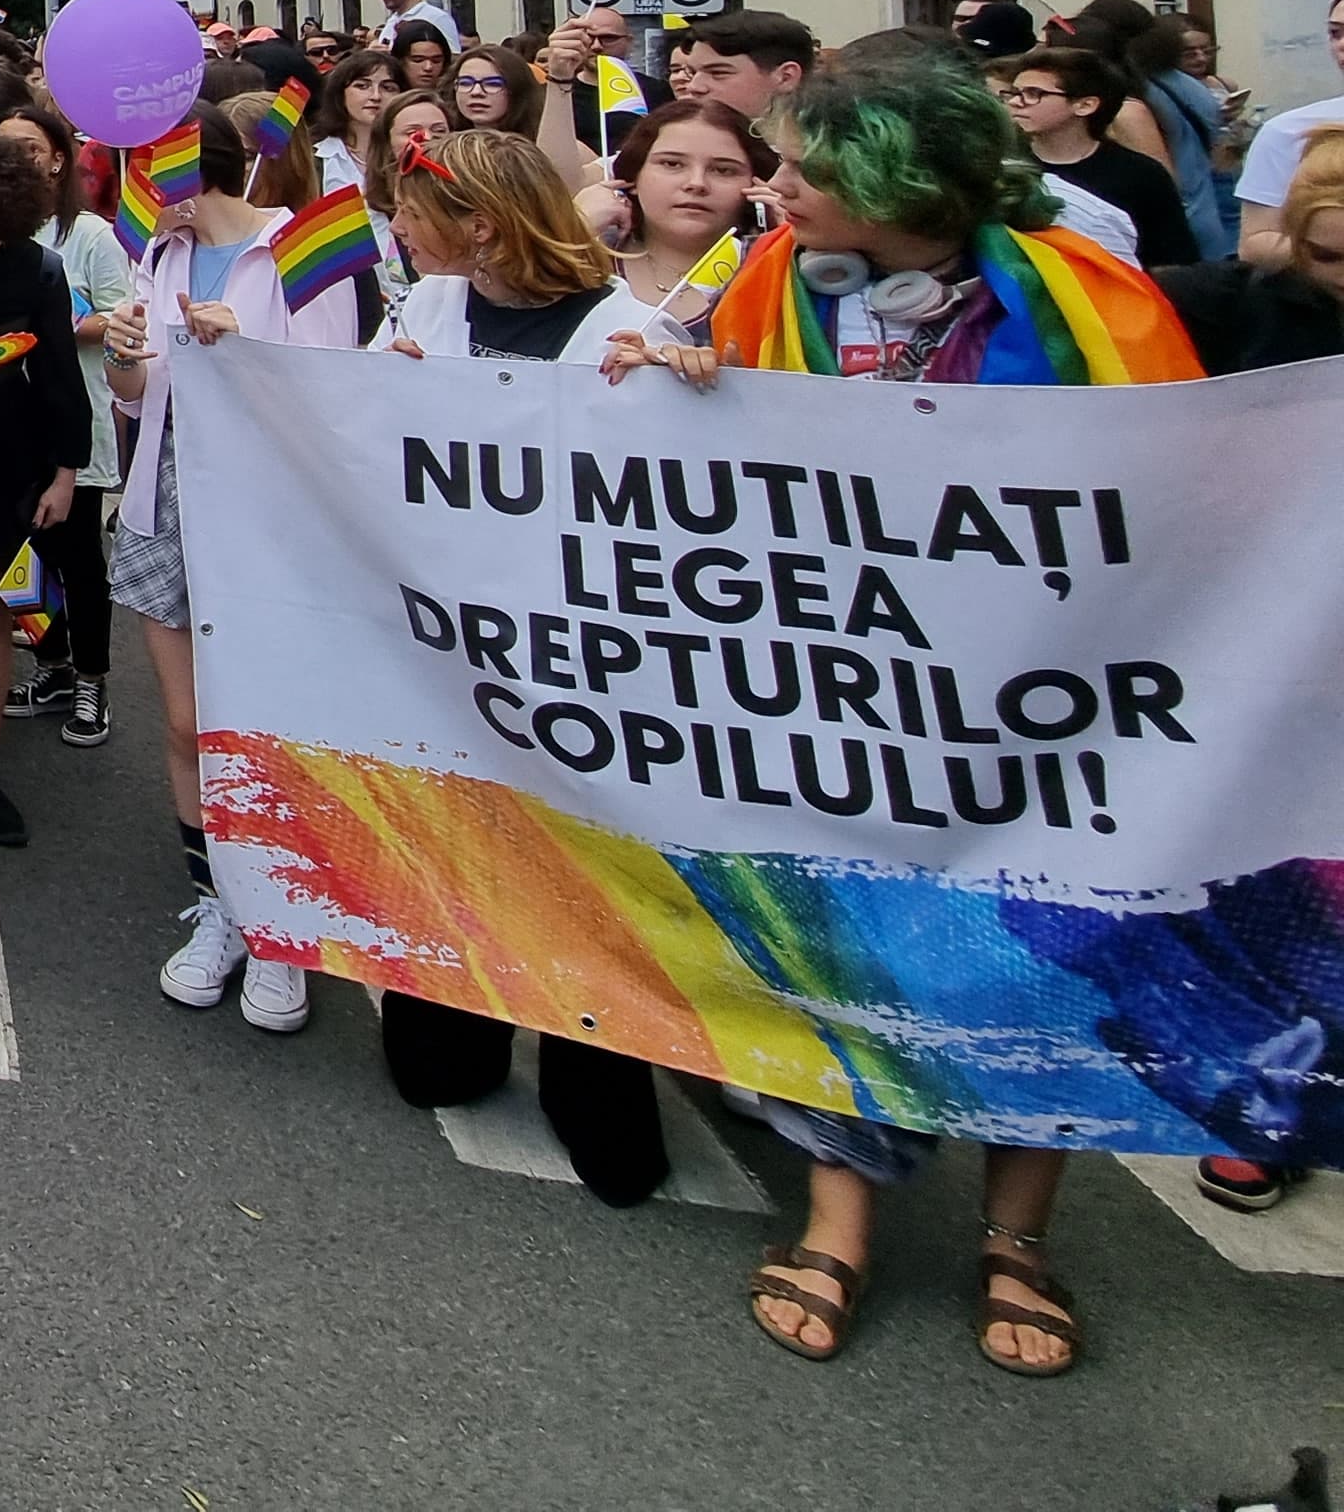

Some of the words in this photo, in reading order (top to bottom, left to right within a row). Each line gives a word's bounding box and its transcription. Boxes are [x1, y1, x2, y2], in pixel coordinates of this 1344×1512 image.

[402, 435, 544, 517] NU
[569, 450, 1132, 603] MUTILAȚI
[559, 533, 933, 651] LEGEA
[397, 581, 1198, 745] DREPTURILOR
[472, 680, 1119, 837] COPILULUI!
